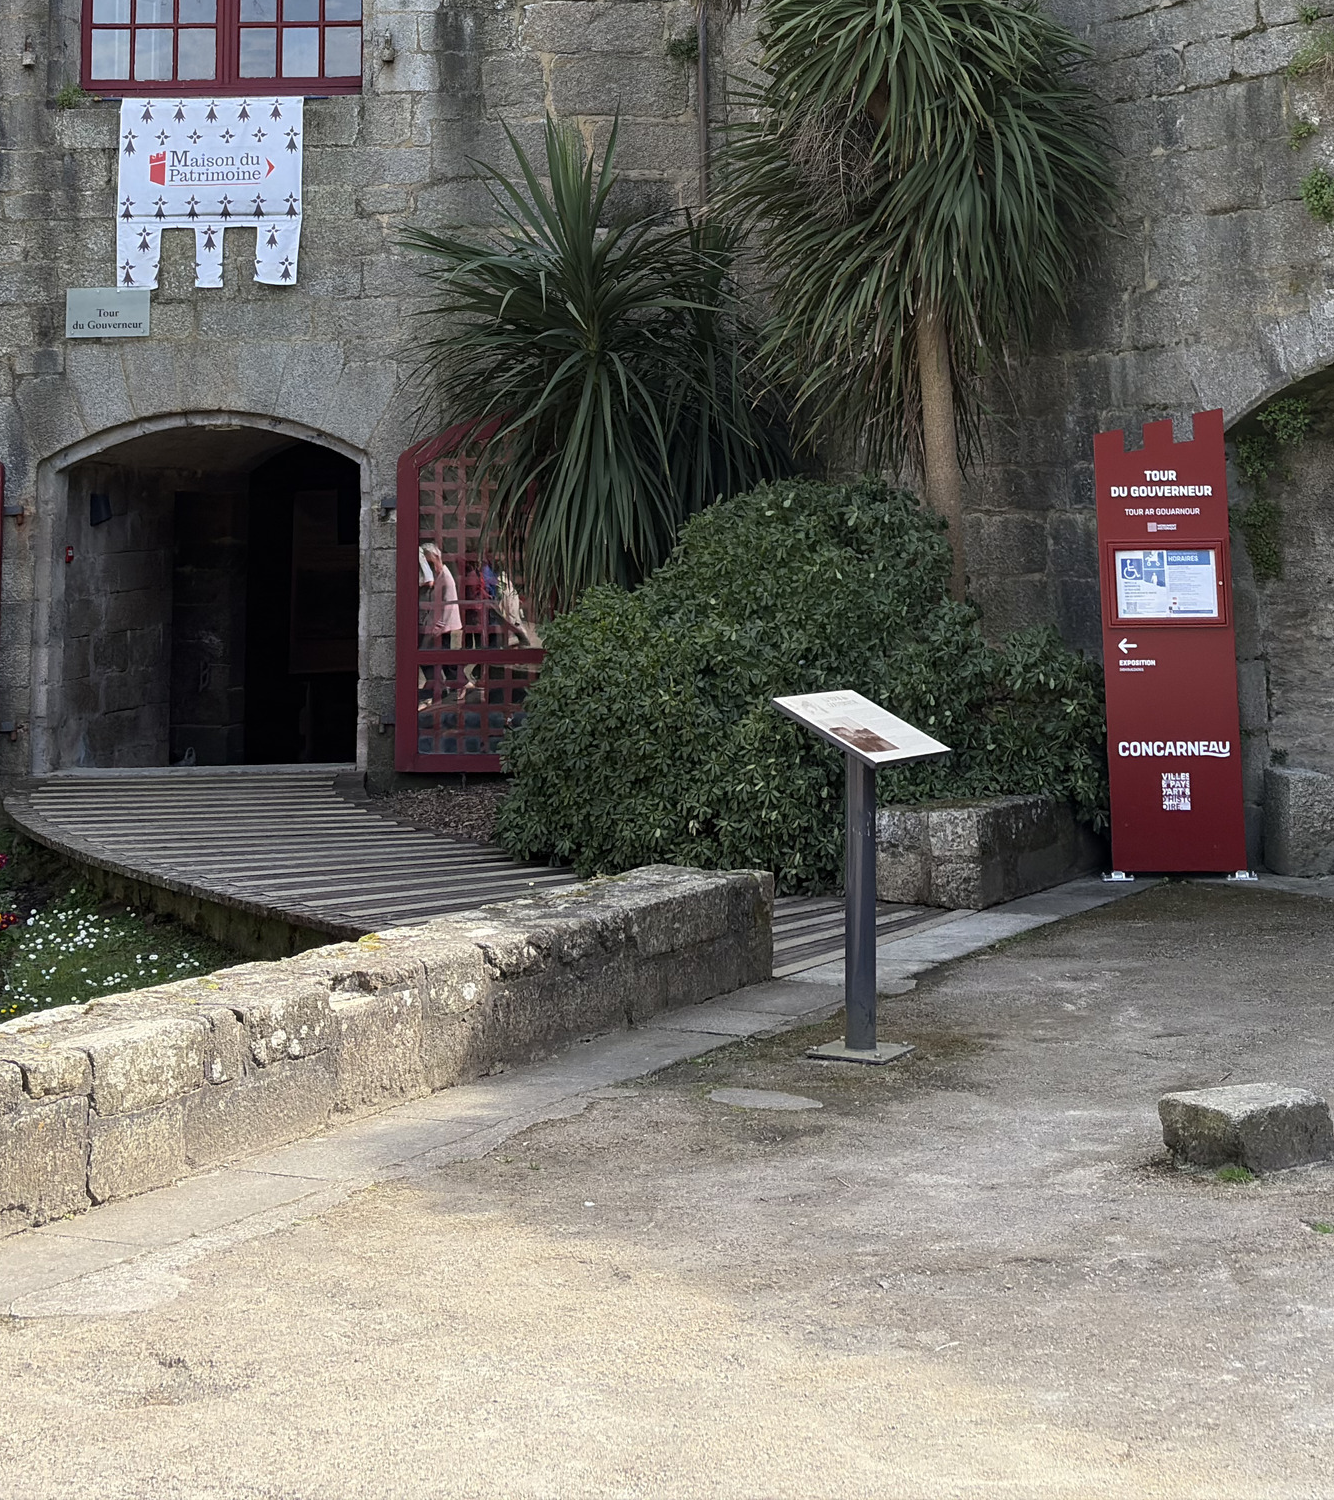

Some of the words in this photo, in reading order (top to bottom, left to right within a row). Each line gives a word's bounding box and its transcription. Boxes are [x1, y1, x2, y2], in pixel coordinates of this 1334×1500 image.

[169, 150, 235, 167] Maison
[239, 153, 260, 166] du
[169, 167, 261, 182] Patrimoine
[96, 308, 119, 317] Tour
[72, 320, 84, 329] du
[87, 320, 143, 329] Gouverneur
[1144, 470, 1177, 481] TOUR
[1110, 486, 1128, 497] DU
[1130, 485, 1212, 497] GOUVERNEUR
[1125, 508, 1144, 516] TOUR
[1155, 507, 1201, 515] GOUARNOUR
[1118, 741, 1231, 758] CONCARNEAU
